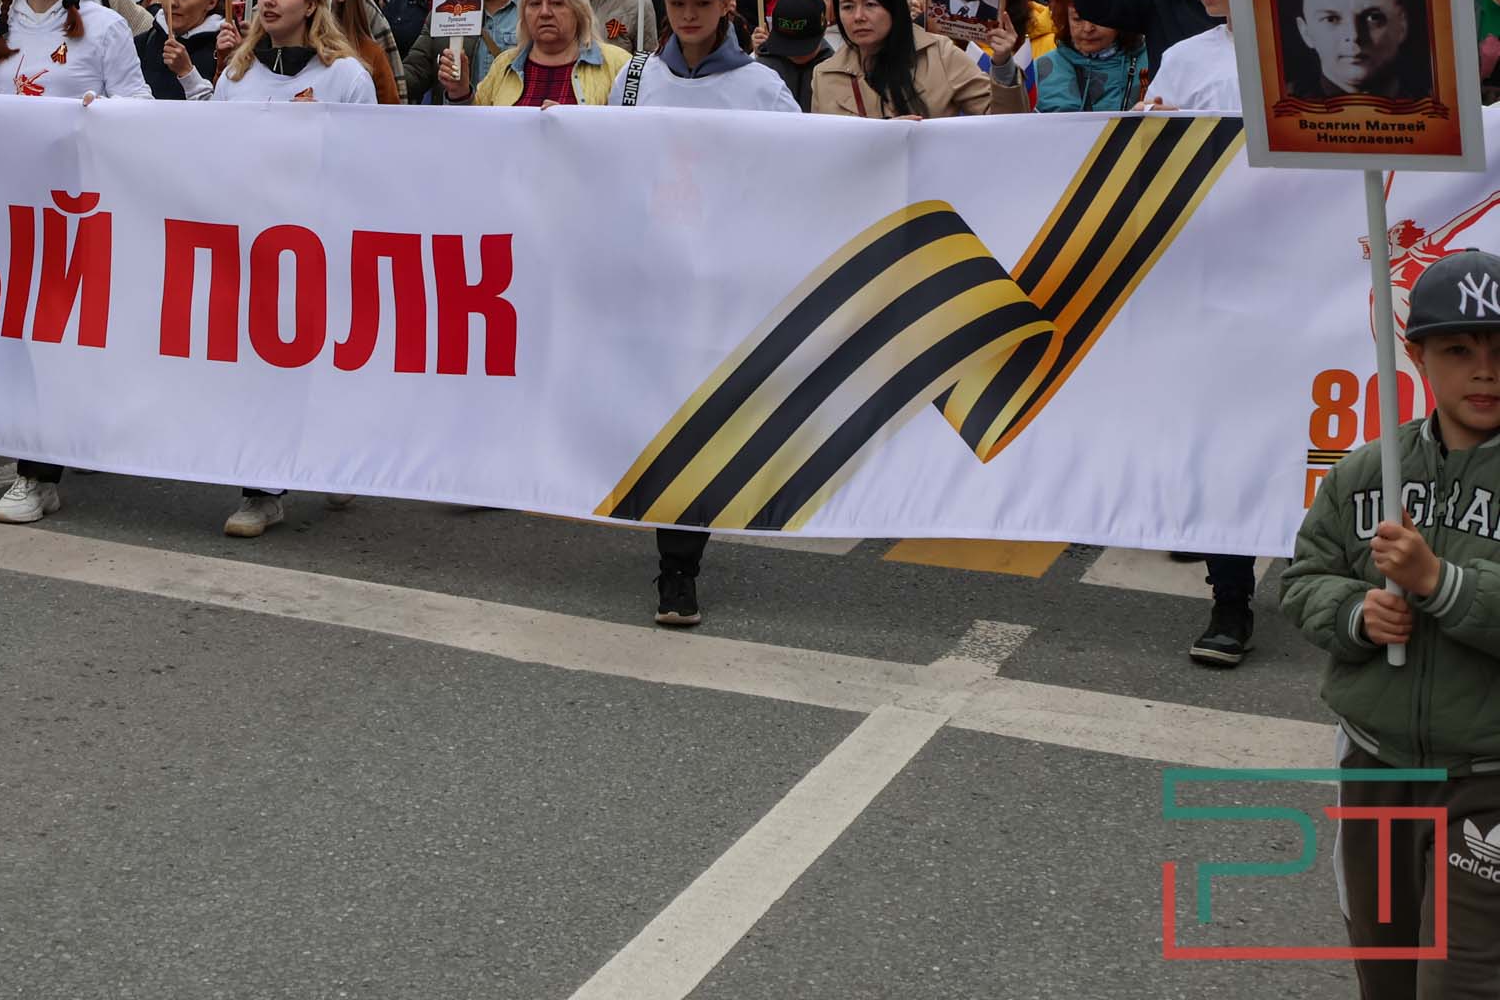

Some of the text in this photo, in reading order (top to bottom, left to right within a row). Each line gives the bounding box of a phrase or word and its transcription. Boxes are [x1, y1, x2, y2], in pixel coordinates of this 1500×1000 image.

[628, 52, 649, 77] NICE
[623, 78, 639, 105] NICE
[1299, 119, 1426, 132] Васягин Матвей
[1316, 132, 1414, 145] Николаевич
[159, 218, 518, 377] ПОЛК
